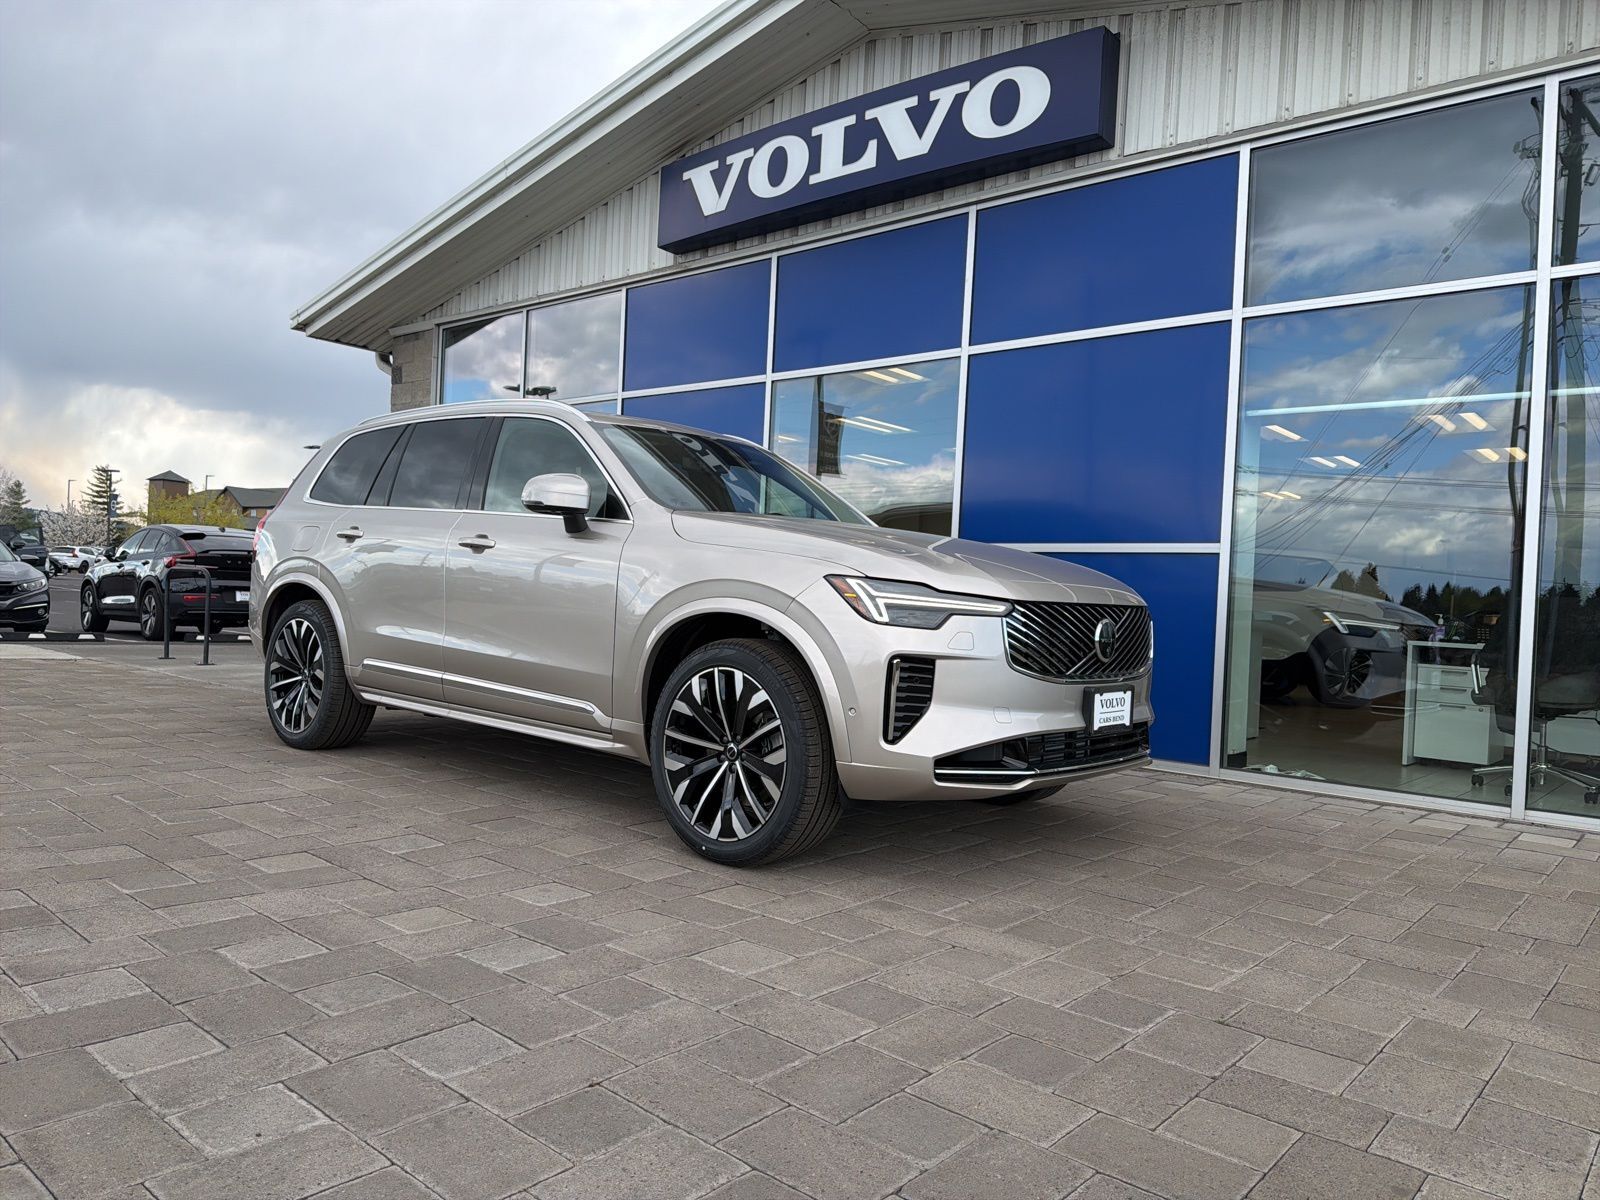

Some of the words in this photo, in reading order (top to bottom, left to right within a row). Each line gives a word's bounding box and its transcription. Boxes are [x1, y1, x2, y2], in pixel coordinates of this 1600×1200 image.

[683, 65, 1051, 217] VOLVO
[1100, 697, 1126, 709] VOLVO
[1099, 716, 1112, 724] CARS
[1112, 715, 1125, 723] BEND
